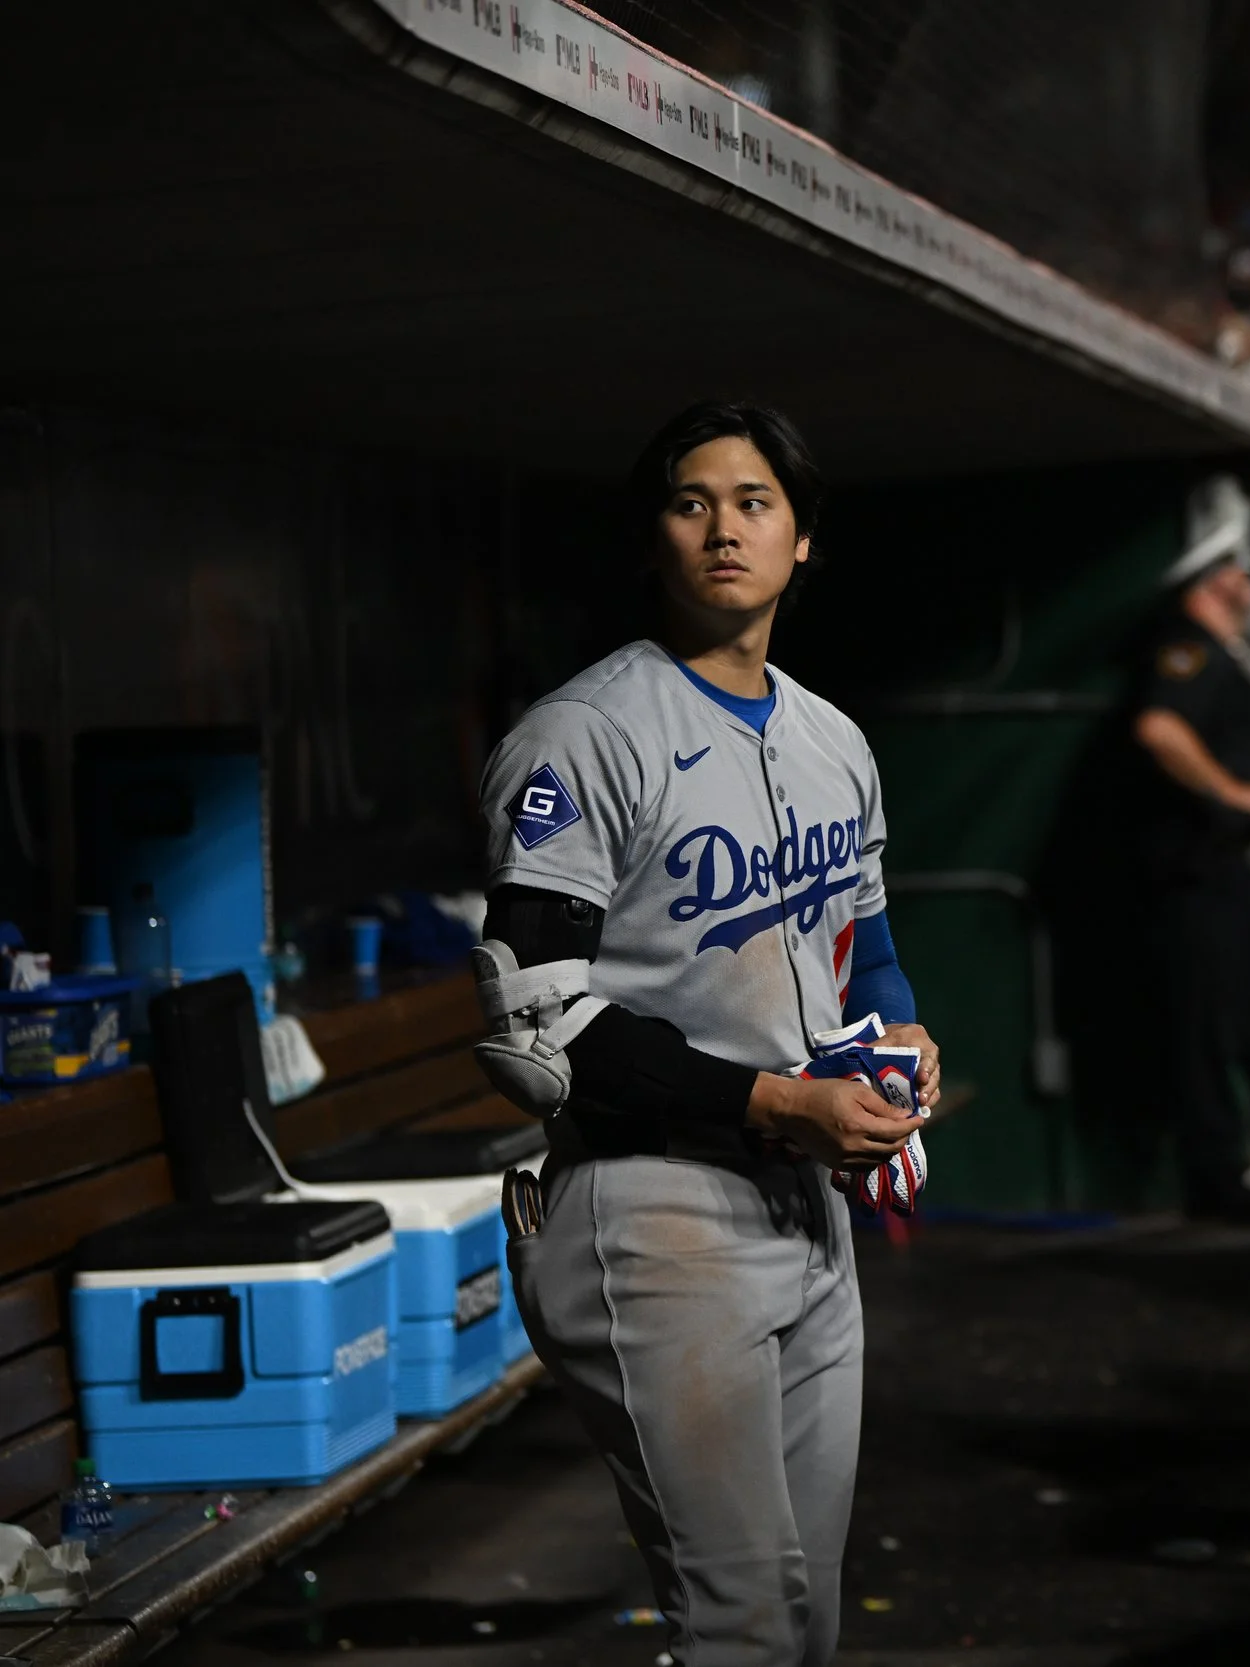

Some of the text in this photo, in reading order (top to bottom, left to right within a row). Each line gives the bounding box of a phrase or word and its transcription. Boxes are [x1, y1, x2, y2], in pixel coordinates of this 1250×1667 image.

[522, 786, 557, 816] G
[516, 814, 556, 826] UGGENHEIM
[907, 1145, 923, 1180] balance
